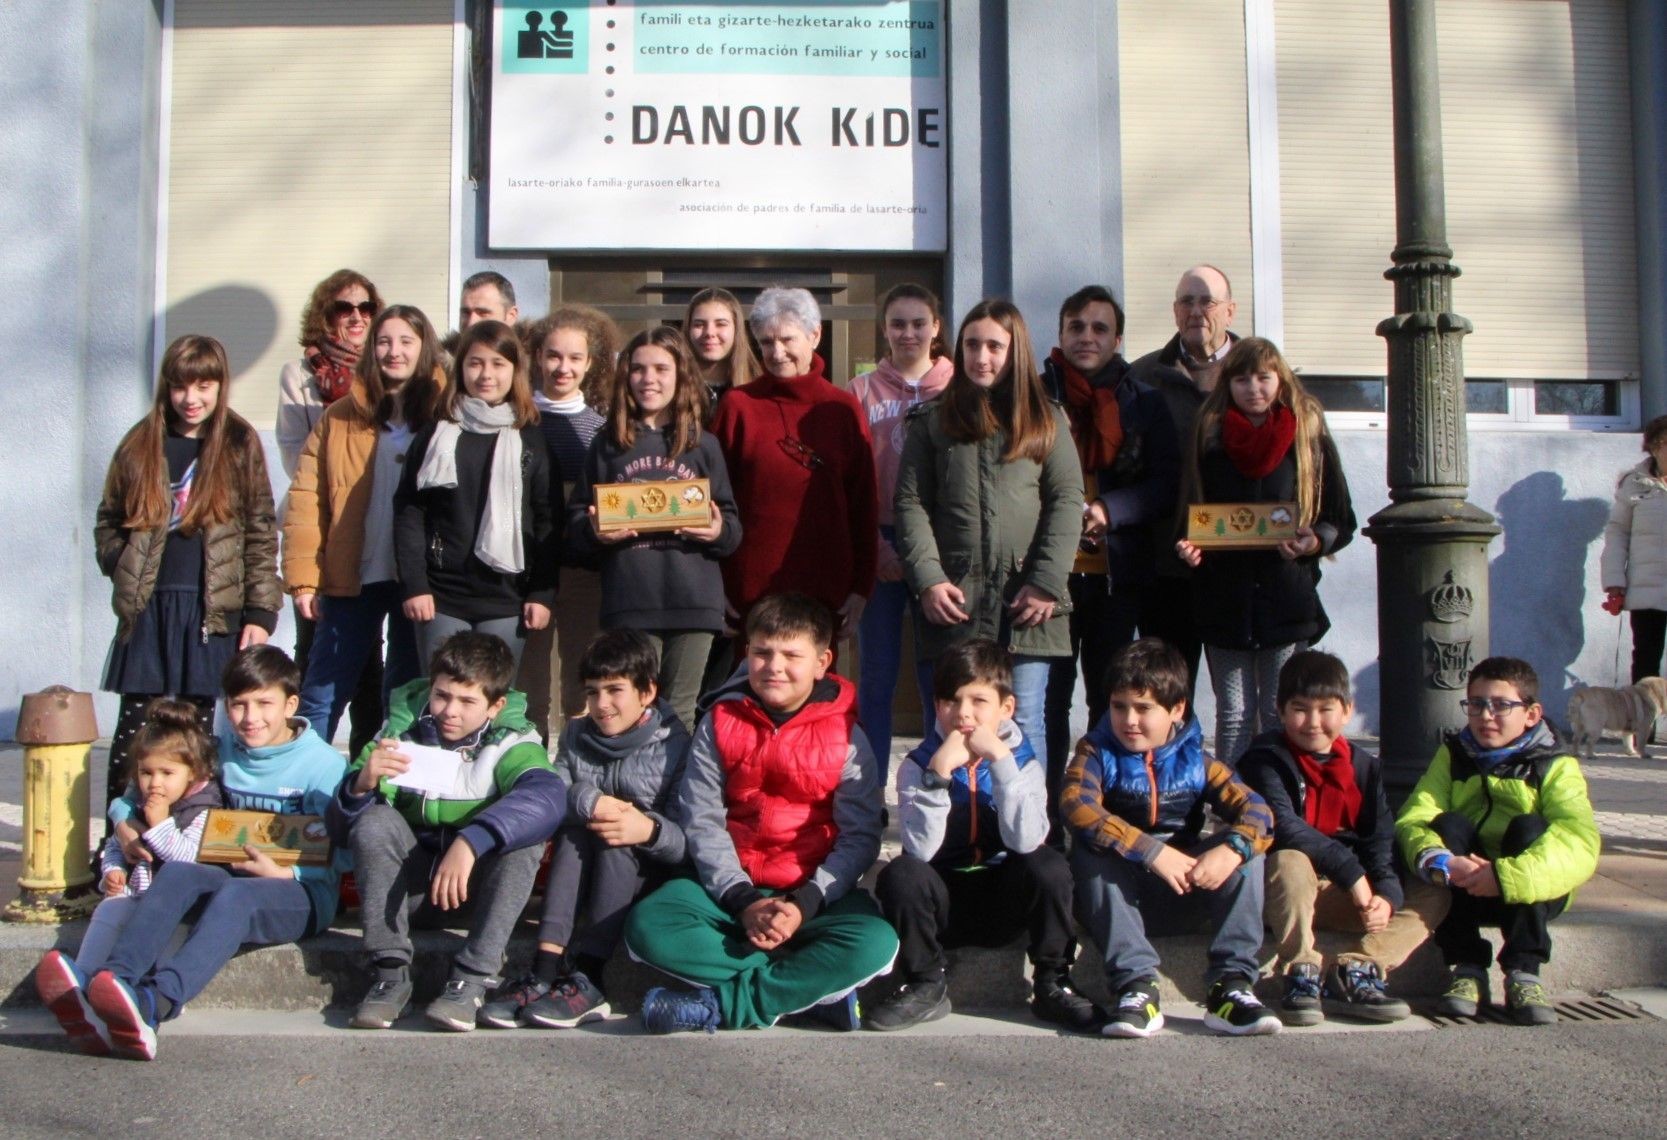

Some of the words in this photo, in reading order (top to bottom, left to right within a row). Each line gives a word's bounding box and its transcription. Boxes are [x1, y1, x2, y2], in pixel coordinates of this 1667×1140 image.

[640, 12, 682, 25] famili
[687, 14, 712, 26] eta
[718, 12, 872, 30] gizarte-hezketarako
[878, 16, 935, 30] zentrua
[639, 43, 689, 55] centro
[695, 42, 713, 56] de
[720, 43, 798, 57] formación
[804, 44, 864, 58] familiar
[870, 48, 878, 61] y
[885, 46, 927, 59] social
[631, 104, 802, 146] DANOK
[831, 107, 940, 147] KIDE
[508, 177, 583, 188] lasarte-oriako
[676, 177, 721, 188] elkartea
[679, 202, 733, 213] asociación
[737, 202, 750, 213] de
[753, 203, 790, 215] padres
[793, 202, 806, 213] de
[810, 203, 846, 214] familia
[850, 203, 863, 214] de
[866, 204, 928, 215] lasarte-oria
[625, 456, 652, 475] MORE
